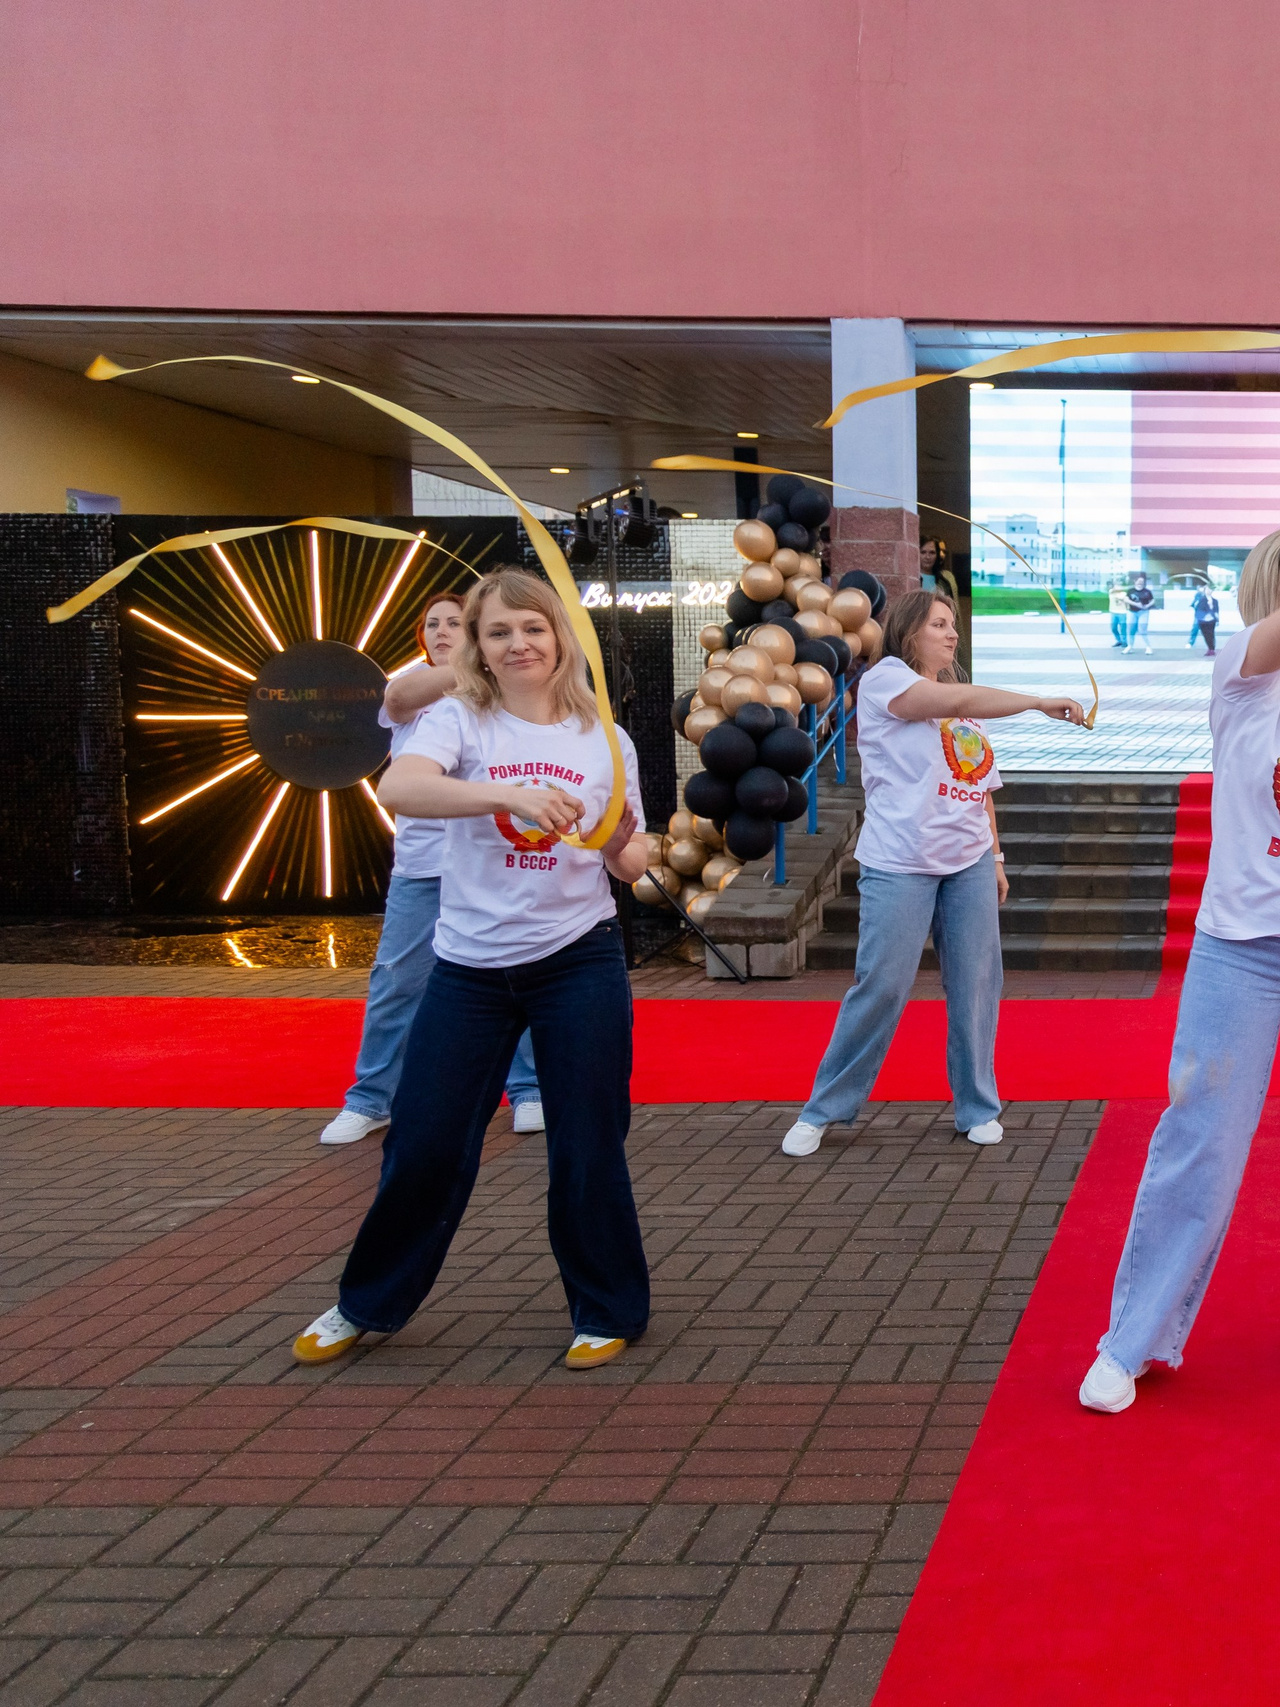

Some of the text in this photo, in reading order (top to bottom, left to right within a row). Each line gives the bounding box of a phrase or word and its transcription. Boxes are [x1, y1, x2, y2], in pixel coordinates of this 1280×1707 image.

[681, 581, 733, 606] 202
[938, 782, 948, 796] В
[505, 853, 557, 871] В СССР
